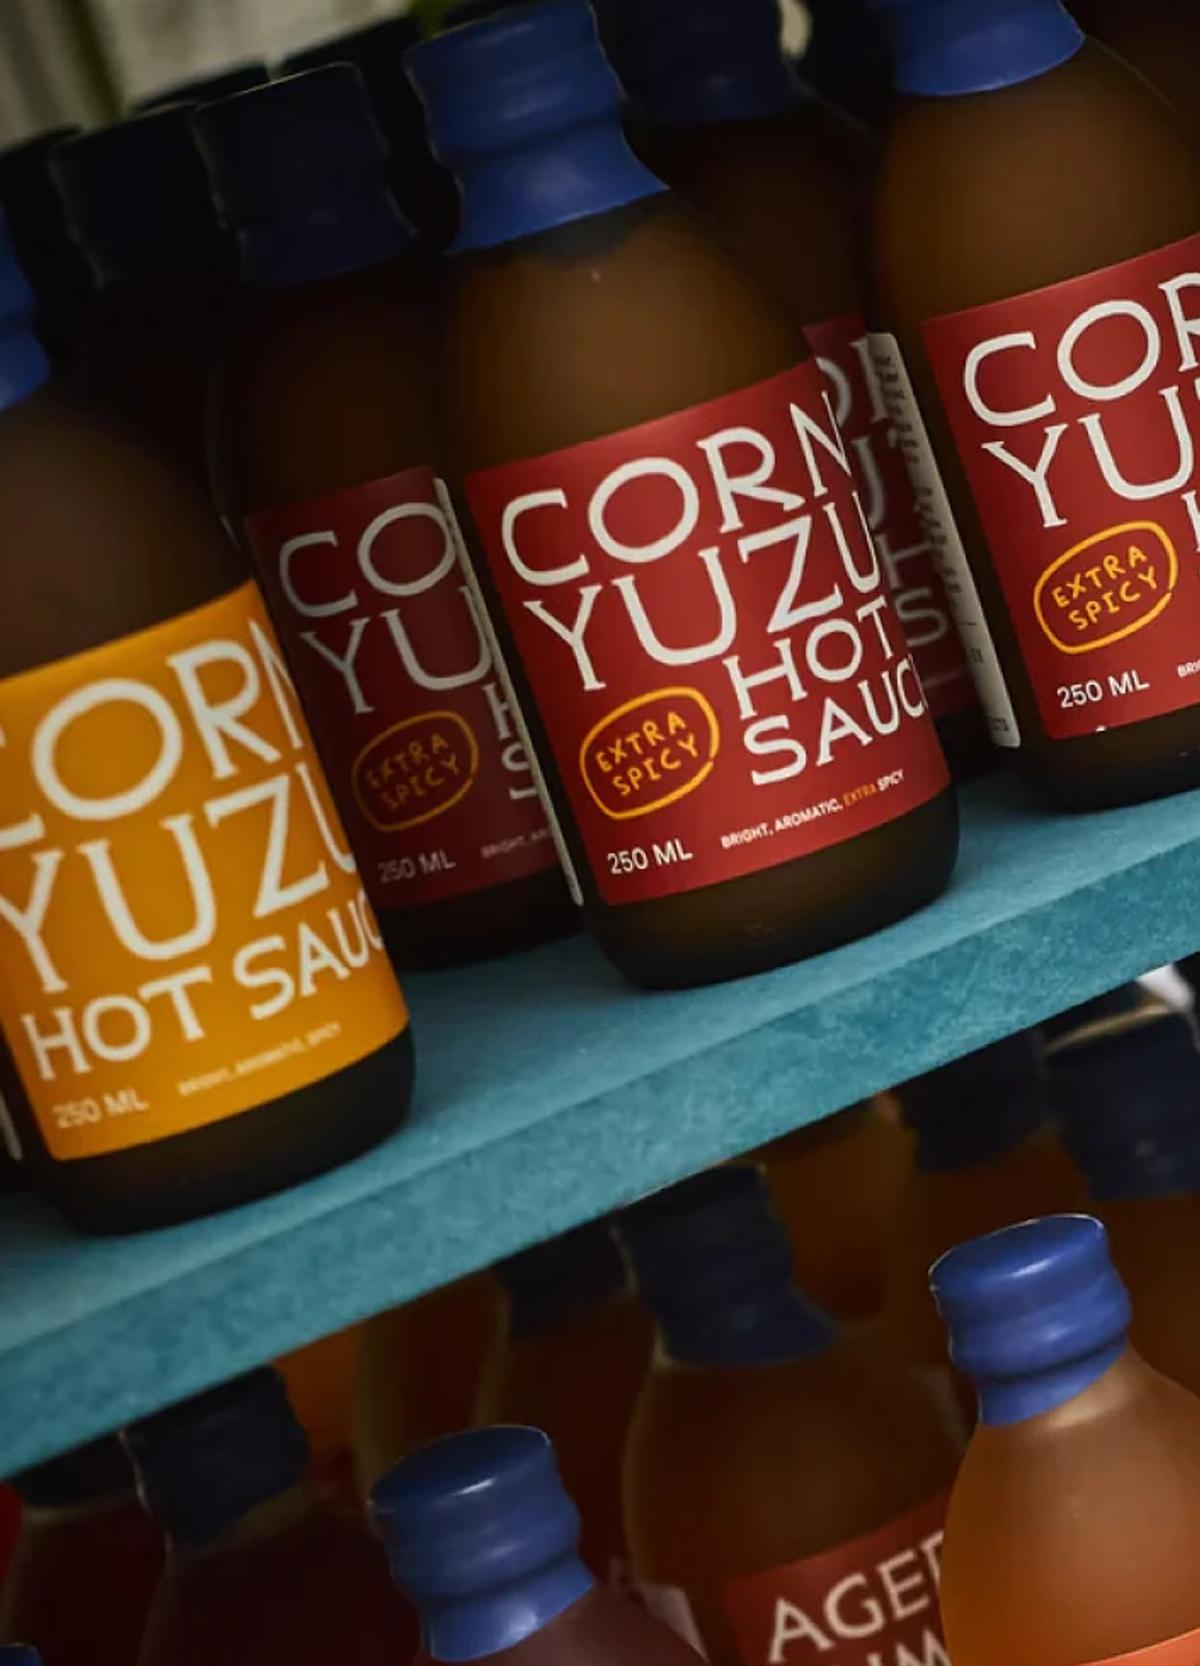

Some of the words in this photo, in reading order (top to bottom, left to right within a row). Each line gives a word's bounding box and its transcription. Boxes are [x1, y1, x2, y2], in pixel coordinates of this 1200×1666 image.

[501, 391, 855, 586] CORN
[523, 491, 882, 691] YUZU
[1051, 545, 1147, 609] EXTRA
[1068, 566, 1159, 631] SPICY
[723, 595, 894, 719] HOT
[1057, 679, 1103, 708] 250
[1107, 669, 1150, 698] ML
[0, 618, 304, 850] ORN
[594, 710, 687, 773] EXTRA
[742, 653, 928, 785] SAUC
[366, 733, 449, 788] EXTRA
[382, 754, 460, 810] SPICY
[612, 734, 700, 796] SPICY
[720, 822, 774, 849] BRIGHT,
[774, 798, 844, 832] AROMATIC,
[843, 783, 878, 806] EXTRA
[877, 768, 905, 792] SPICY
[378, 858, 416, 883] 250
[418, 850, 456, 874] ML
[607, 847, 648, 874] 250
[652, 838, 693, 867] ML
[21, 965, 212, 1080] HOT
[53, 1097, 101, 1129] 250
[104, 1089, 150, 1117] ML
